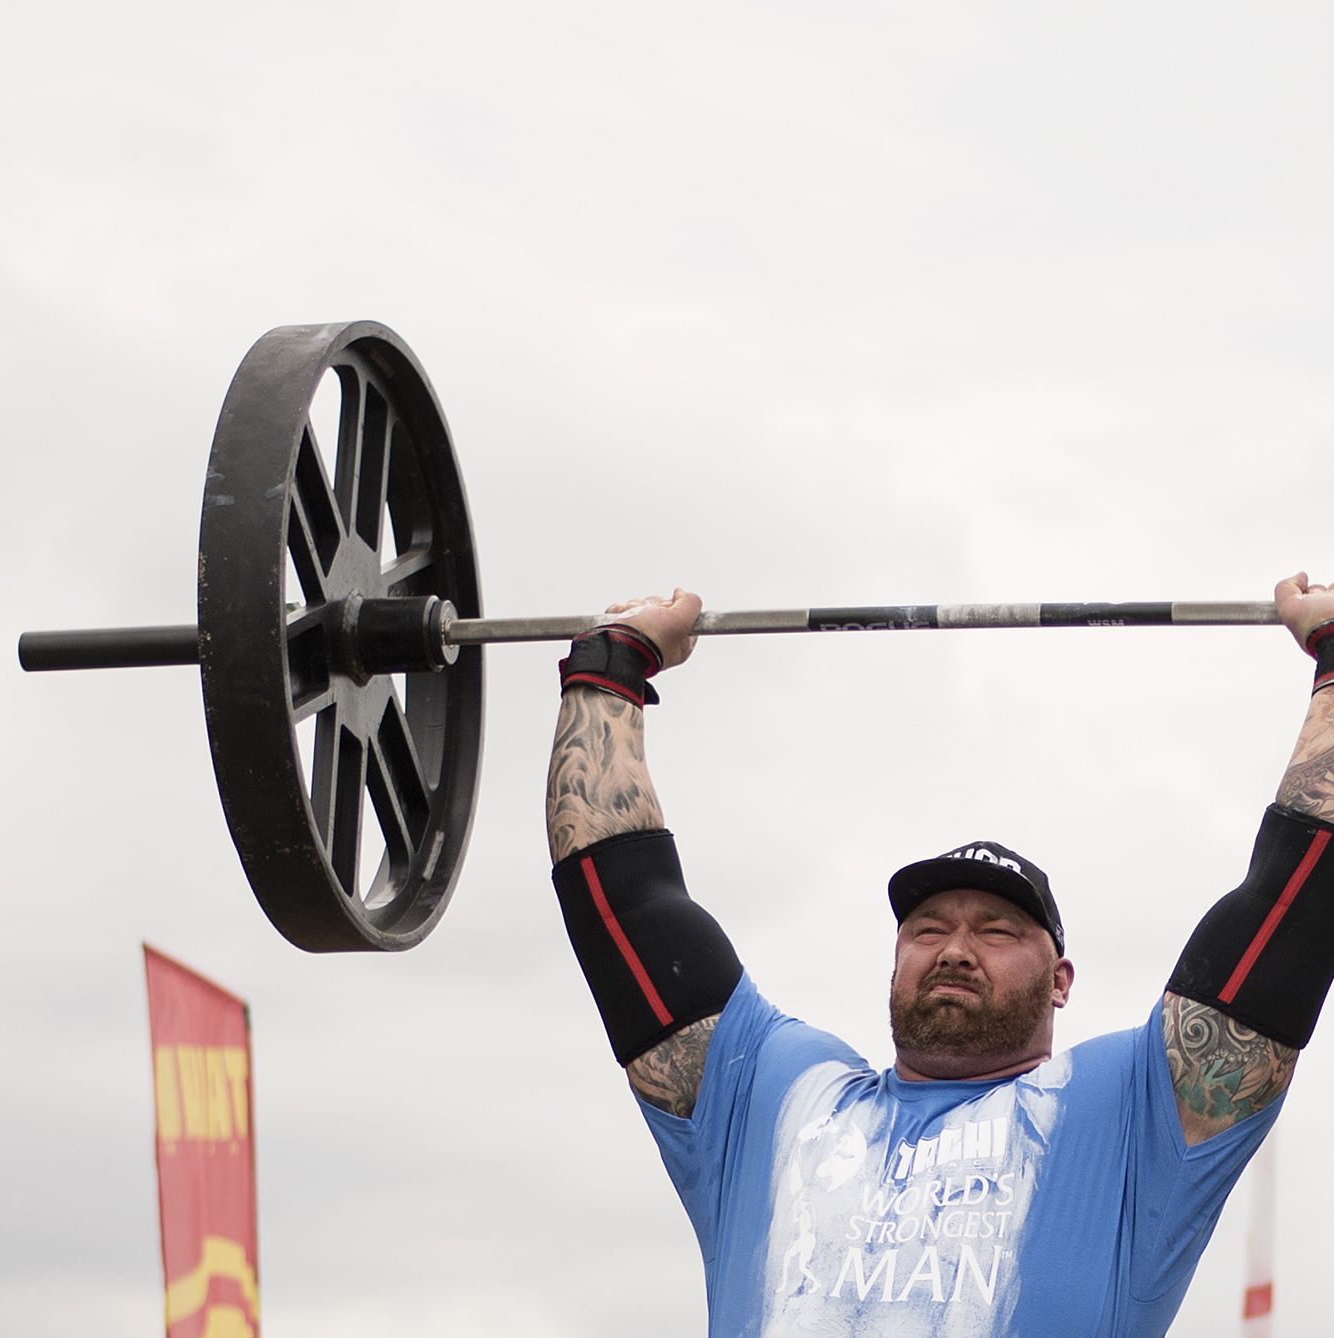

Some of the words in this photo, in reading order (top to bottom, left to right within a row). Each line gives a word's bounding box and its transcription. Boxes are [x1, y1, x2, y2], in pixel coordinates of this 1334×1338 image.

[862, 1173, 1014, 1217] WORLD'S
[846, 1211, 1013, 1244] STRONGEST
[829, 1244, 1004, 1306] MAN
